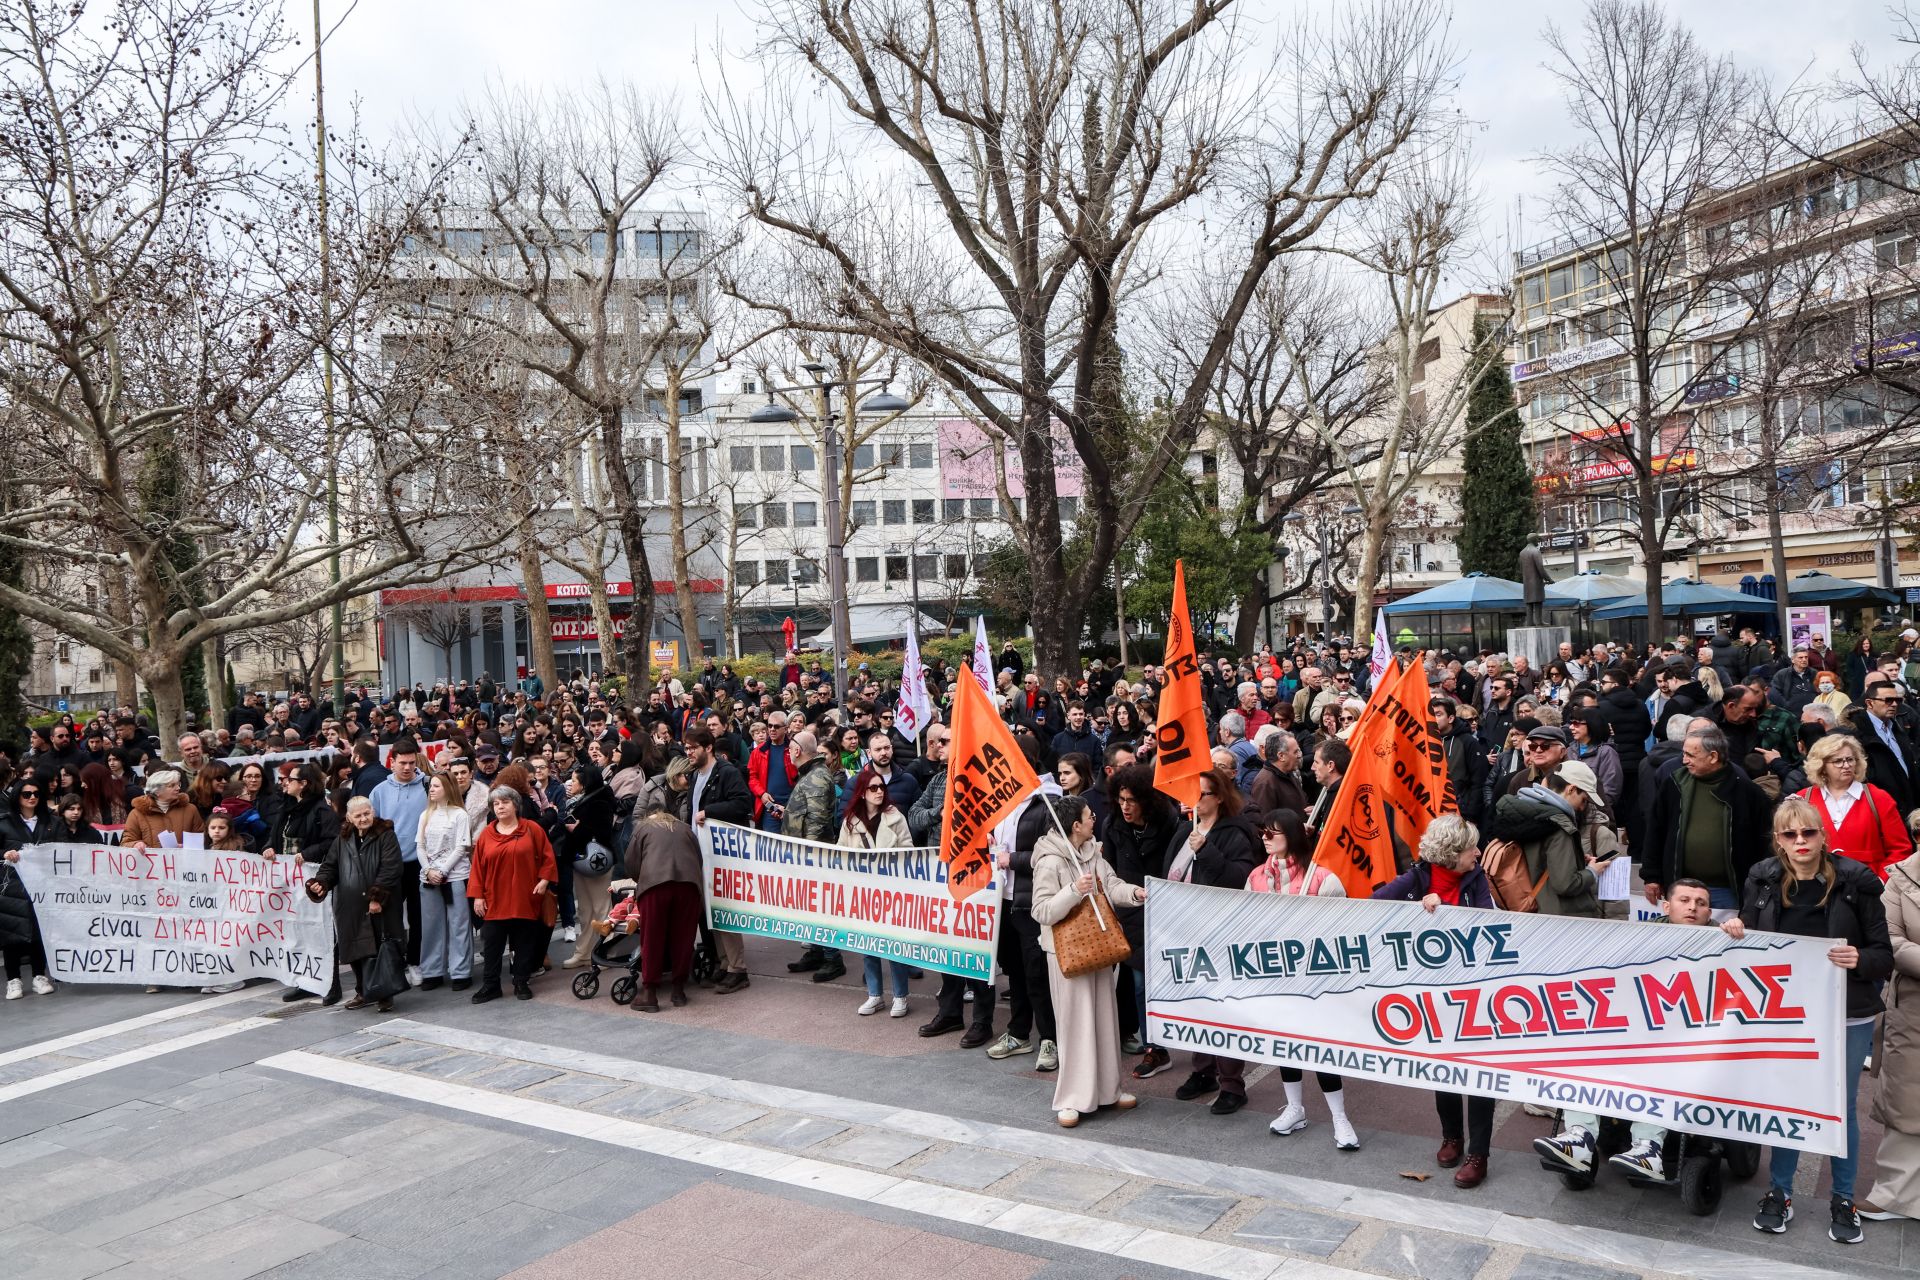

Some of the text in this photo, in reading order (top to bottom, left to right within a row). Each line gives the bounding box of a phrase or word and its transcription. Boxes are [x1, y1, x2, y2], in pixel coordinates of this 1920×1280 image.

[1720, 563, 1742, 573] LOOK
[1817, 554, 1874, 566] DRESSING
[53, 849, 304, 890] Η ΓΝΩΣΗ και η ΑΣΦΑΛΕΙΑ
[710, 826, 752, 860] ΕΣΕΙΣ
[903, 850, 931, 882] ΚΑΙ
[1336, 825, 1374, 879] ΣΤΟΝ
[55, 886, 112, 905] παιδιών
[121, 892, 147, 911] μας
[156, 887, 180, 907] δεν
[189, 891, 218, 910] είναι
[229, 888, 297, 914] ΚΟΣΤΟΣ
[88, 912, 143, 938] είναι
[713, 867, 996, 942] ΕΜΕΙΣ ΜΙΛΑΜΕ ΓΙΑ ΑΝΘΡΩΠΙΝΕΣ ΖΩΕΣ
[55, 946, 323, 982] ΕΝΩΣΗ ΓΟΝΕΩΝ ΛΑΡΙΣΑΣ
[713, 910, 769, 931] ΣΥΛΛΟΓΟΣ
[771, 919, 813, 940] ΙΑΤΡΩΝ
[814, 927, 838, 943] ΕΣΥ
[846, 932, 948, 966] ΕΙΔΙΚΕΥΟΜΕΝΩΝ
[1161, 923, 1520, 984] ΤΑ ΚΕΡΔΗ ΤΟΥΣ
[1372, 964, 1806, 1045] ΟΙ ΖΩΕΣ ΜΑΣ
[1162, 1022, 1266, 1056] ΣΥΛΛΟΓΟΣ
[1272, 1039, 1469, 1087] ΕΚΠΑΙΔΕΥΤΙΚΩΝ
[1476, 1071, 1511, 1094] ΠΕ
[1526, 1077, 1665, 1118] "ΚΩΝ/ΝΟΣ
